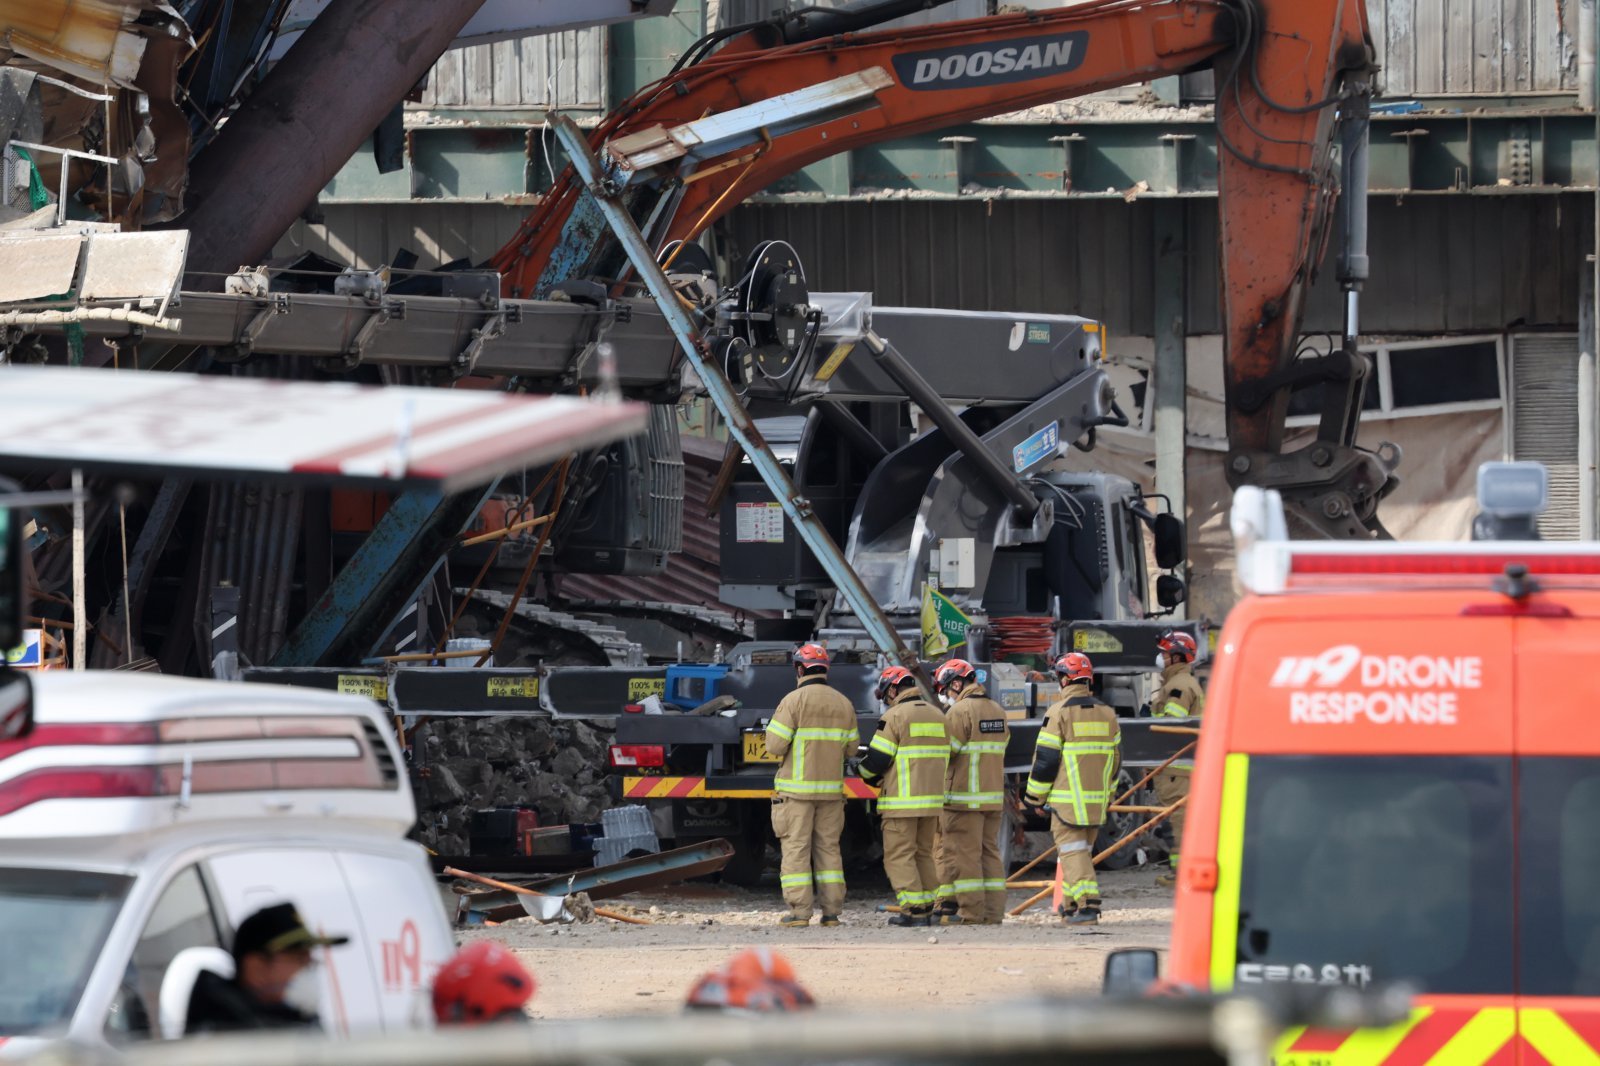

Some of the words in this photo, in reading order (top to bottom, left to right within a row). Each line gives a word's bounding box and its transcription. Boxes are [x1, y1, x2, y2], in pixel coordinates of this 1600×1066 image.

[913, 40, 1073, 84] DOOSAN
[630, 681, 650, 689] 100%
[1360, 655, 1483, 688] DRONE
[1289, 691, 1458, 724] RESPONSE
